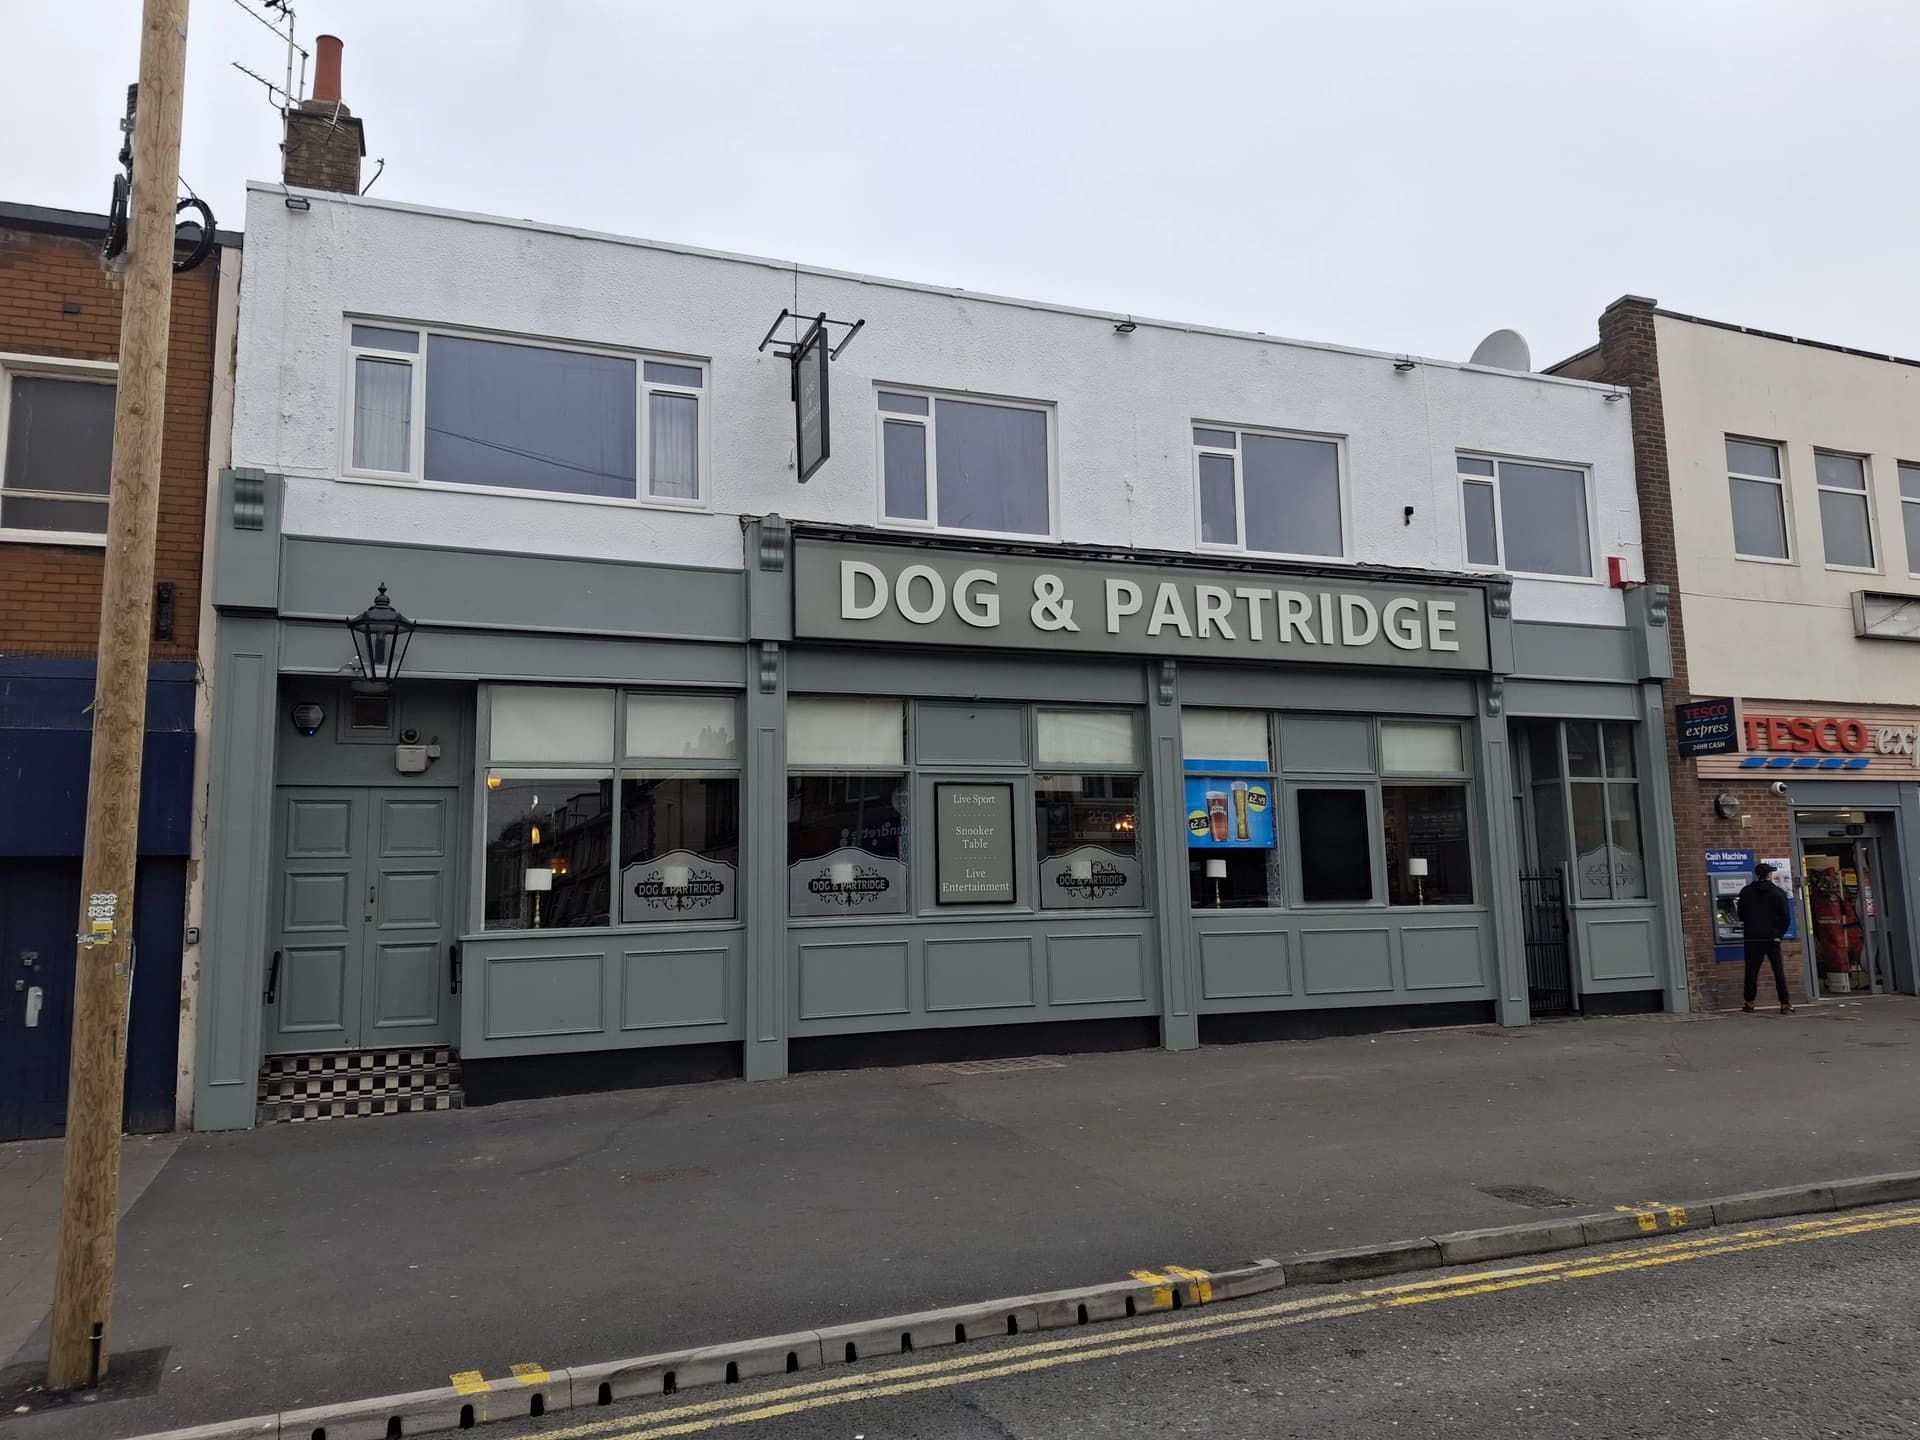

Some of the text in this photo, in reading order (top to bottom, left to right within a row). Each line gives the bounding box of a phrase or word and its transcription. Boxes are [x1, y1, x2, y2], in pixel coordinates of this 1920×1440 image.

[841, 560, 1460, 652] DOG & PARTRIDGE
[1684, 705, 1728, 719] TESCO
[1686, 723, 1729, 738] express
[1743, 715, 1869, 754] TESCO
[1709, 741, 1726, 749] CASH
[953, 794, 995, 806] Live Sport
[955, 826, 994, 836] Snooker
[962, 839, 989, 849] Table
[1705, 852, 1748, 861] Cash Machine
[966, 868, 986, 878] Live
[812, 881, 830, 891] DOG
[840, 879, 885, 890] PARTRIDGE
[1060, 875, 1075, 885] DOG
[1084, 875, 1124, 885] PARTRIDGE
[639, 884, 659, 895] DOG
[670, 882, 721, 895] PARTRIDGE
[942, 881, 1009, 892] Entertainment
